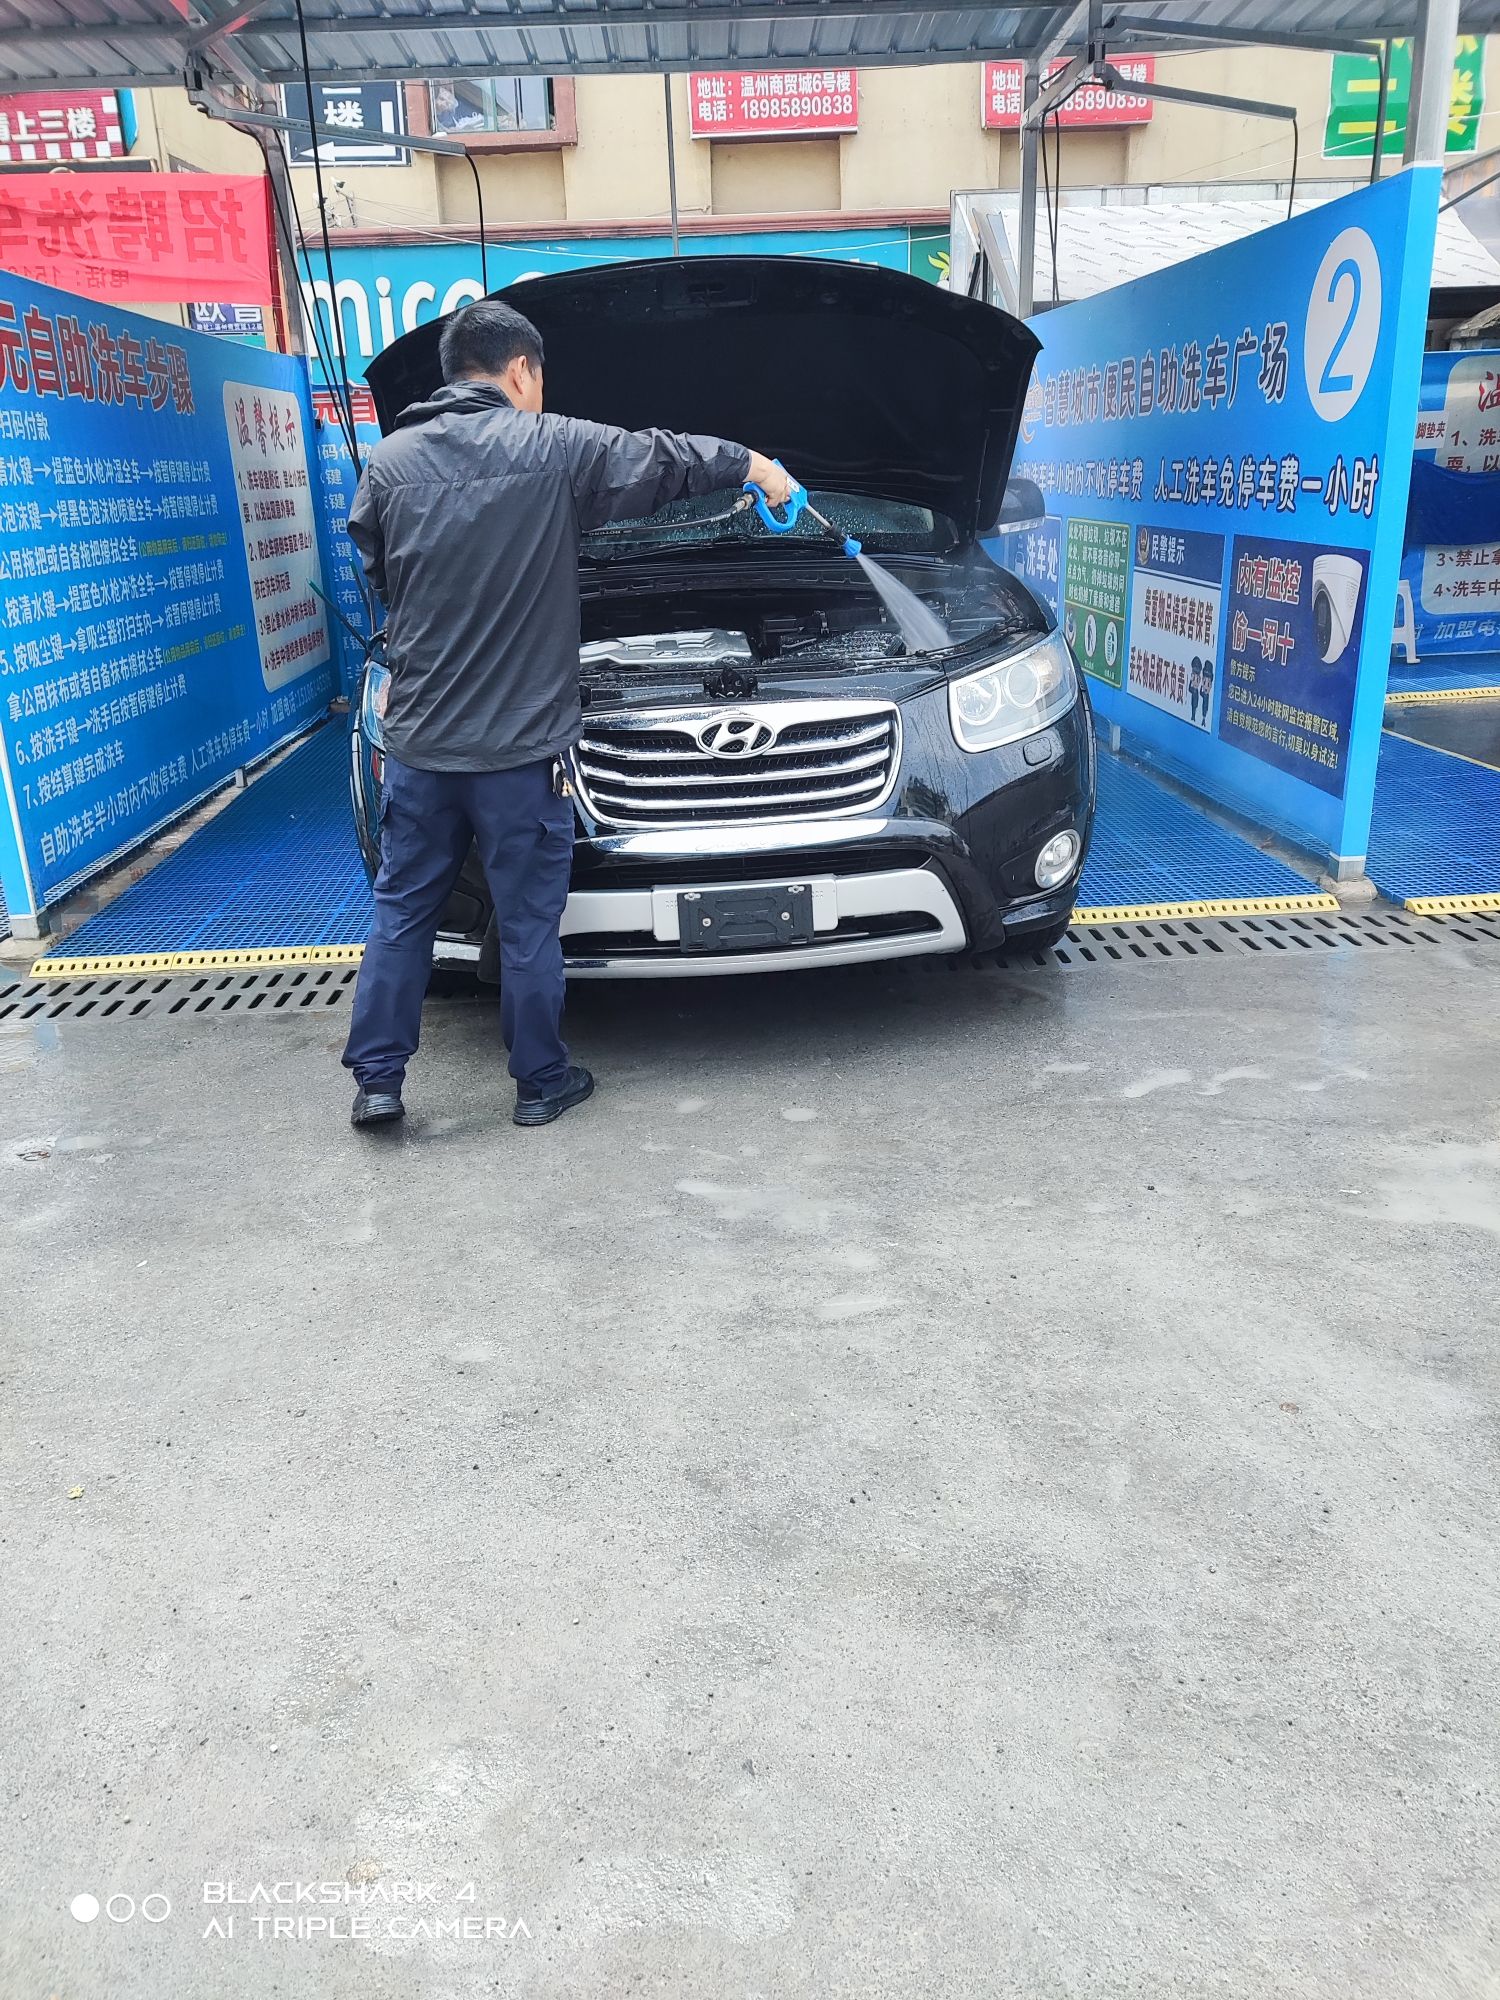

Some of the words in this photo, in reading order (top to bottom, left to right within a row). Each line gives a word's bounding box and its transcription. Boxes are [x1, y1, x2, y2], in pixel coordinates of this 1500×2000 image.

[1318, 258, 1362, 394] 2
[1044, 320, 1290, 429] 智慧城市便民自助洗车广场
[1154, 453, 1380, 519] 人工洗车免停车费一小时
[1151, 534, 1185, 565] 民警提示
[1236, 552, 1302, 605] 内有监控
[1232, 609, 1294, 666] 偷一罚十
